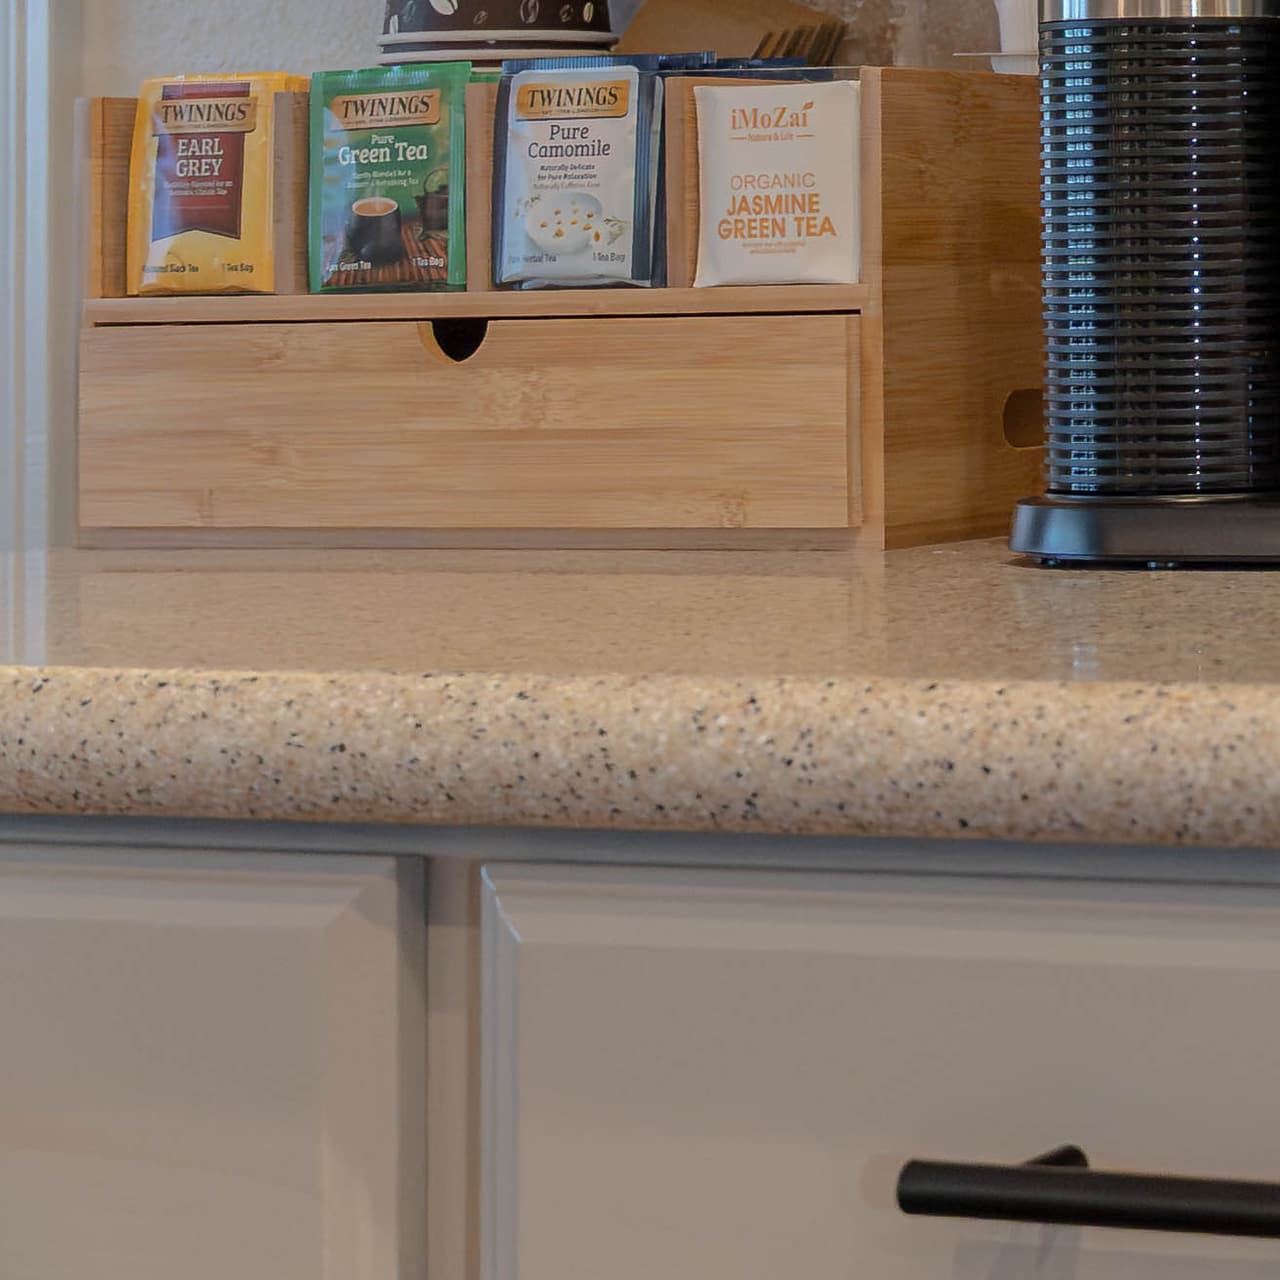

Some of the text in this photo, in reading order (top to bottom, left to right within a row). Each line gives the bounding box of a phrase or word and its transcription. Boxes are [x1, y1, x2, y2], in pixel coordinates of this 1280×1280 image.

[528, 86, 620, 108] TWININGS
[162, 103, 249, 123] TWININGS
[342, 96, 431, 119] TWININGS
[731, 102, 813, 130] iMoZai
[371, 134, 395, 145] Pure
[550, 124, 589, 140] Pure
[177, 138, 224, 156] EARL
[338, 142, 428, 165] Green Tea
[528, 140, 610, 158] Camomile
[176, 158, 223, 177] GREY
[731, 173, 816, 190] ORGANIC
[727, 193, 820, 215] JASMINE
[718, 216, 837, 239] GREEN TEA
